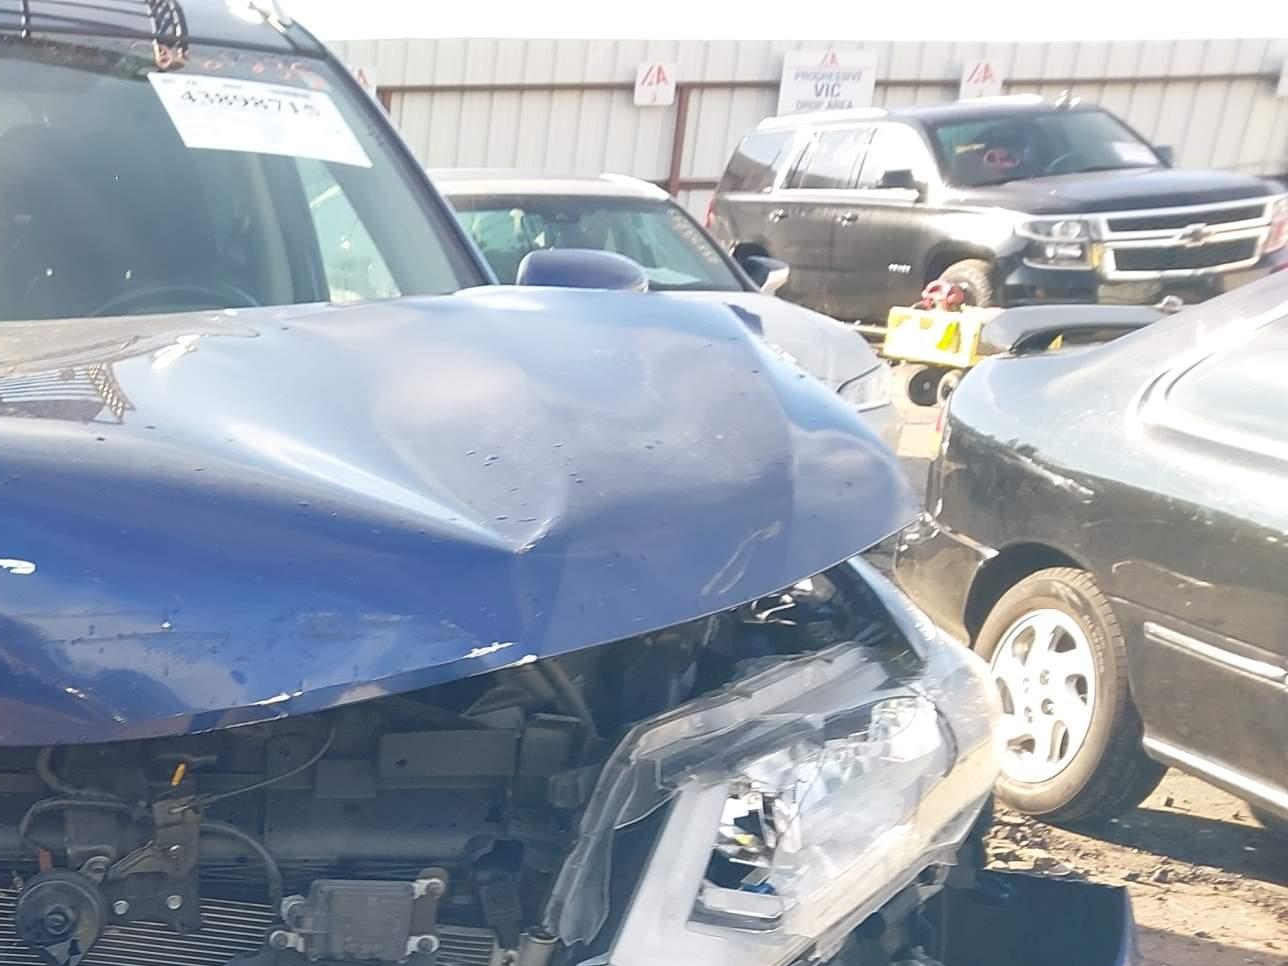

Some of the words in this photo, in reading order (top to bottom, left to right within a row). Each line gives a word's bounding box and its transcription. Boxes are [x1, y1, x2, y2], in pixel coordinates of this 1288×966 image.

[794, 71, 863, 82] PROGRESSIVE
[814, 82, 841, 98] VIC
[180, 89, 321, 117] 43898715
[795, 99, 824, 110] DROP
[825, 99, 853, 110] AREA
